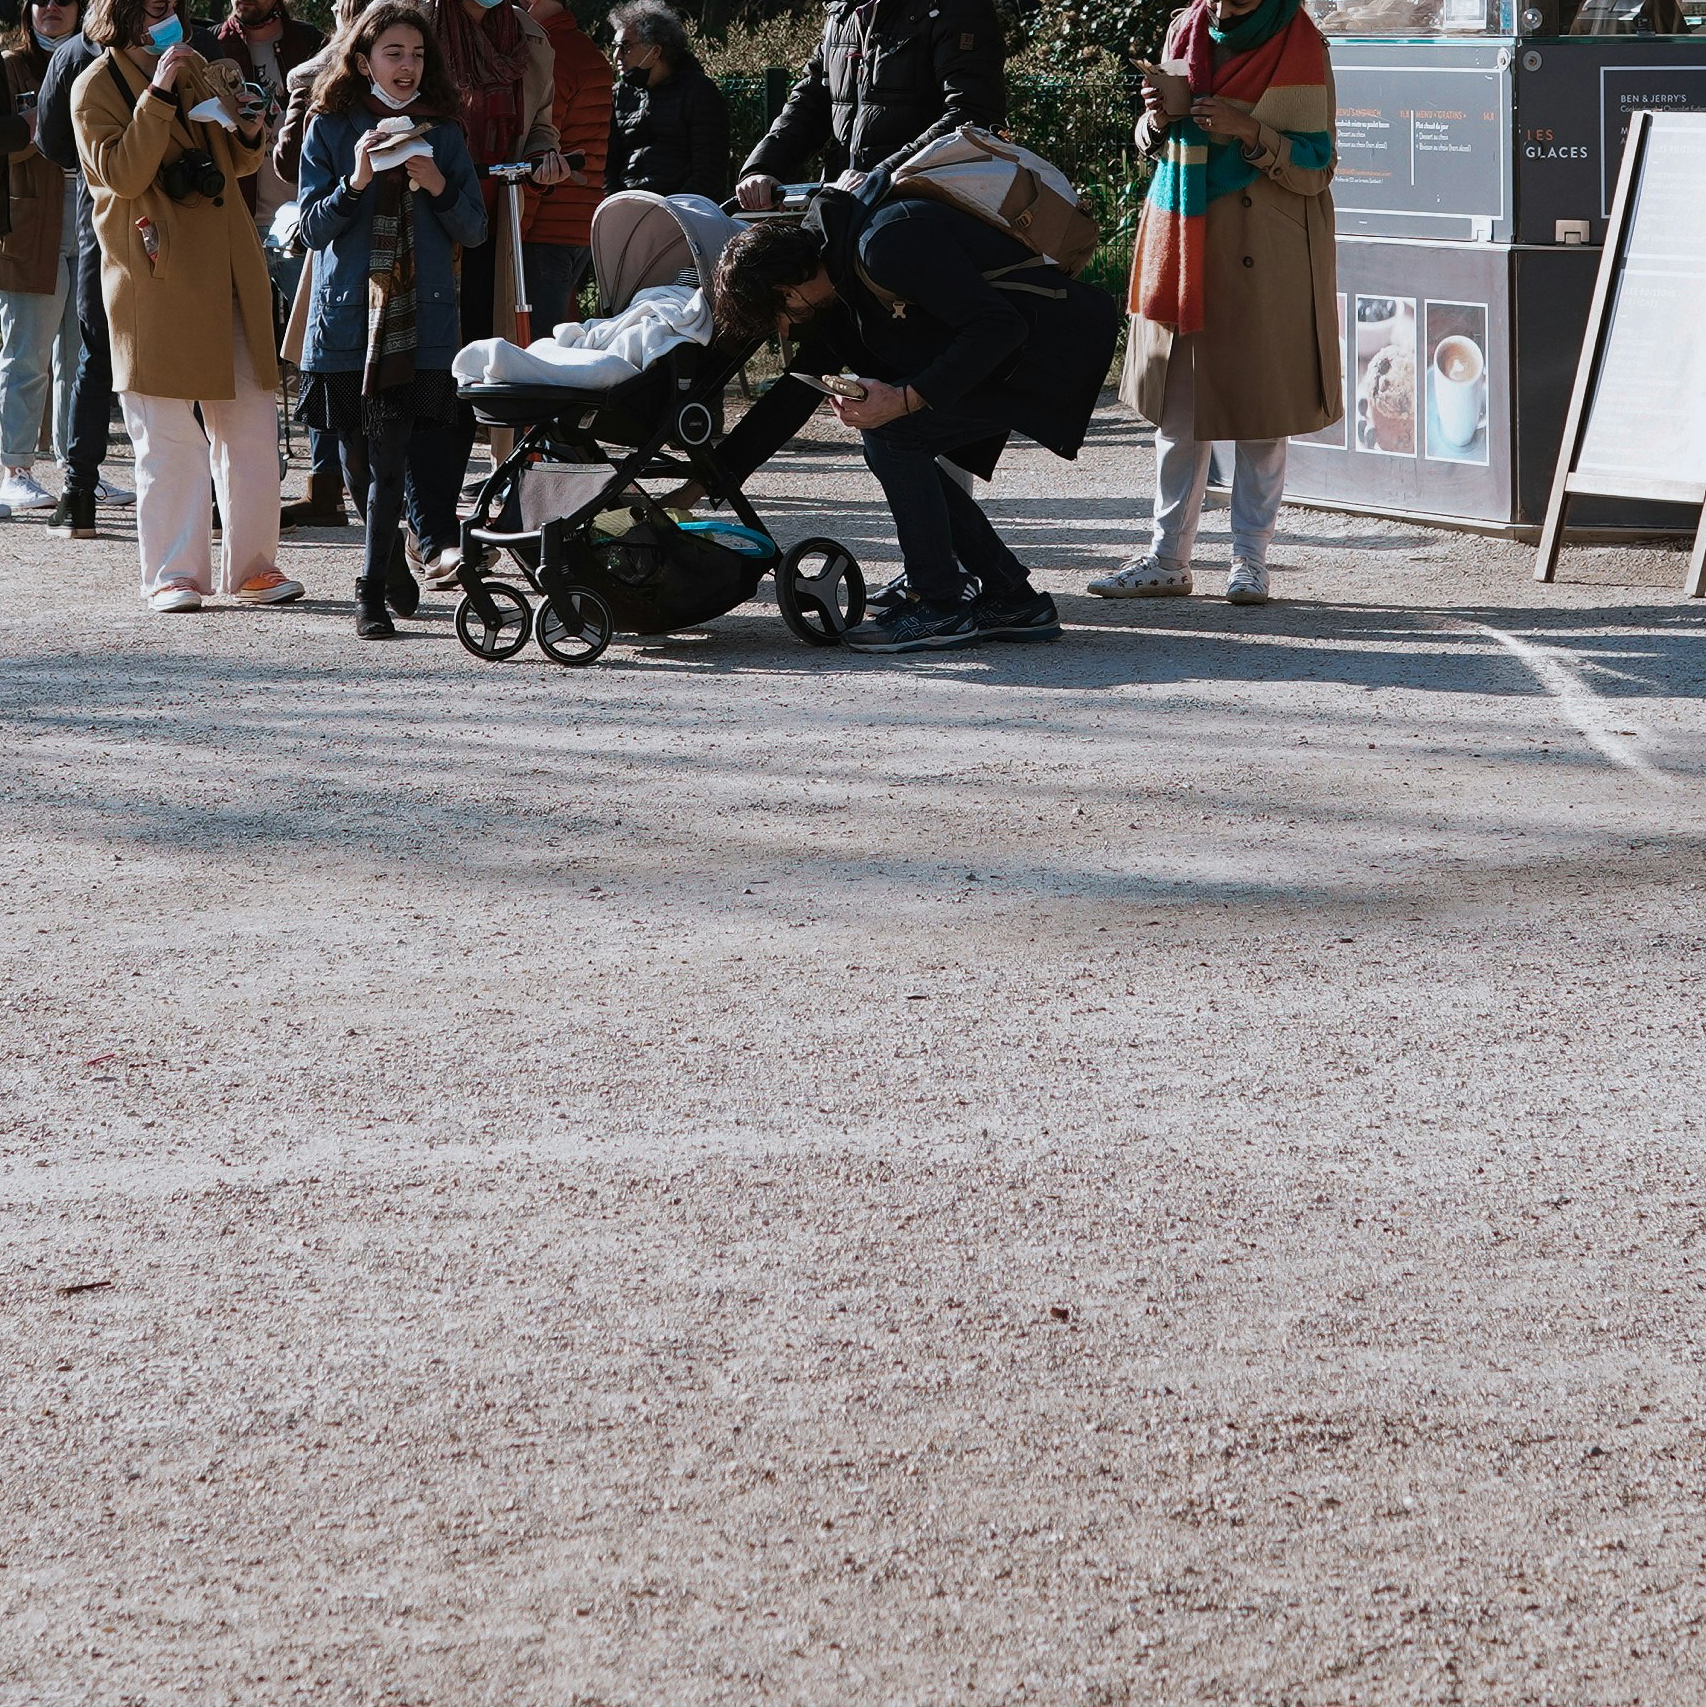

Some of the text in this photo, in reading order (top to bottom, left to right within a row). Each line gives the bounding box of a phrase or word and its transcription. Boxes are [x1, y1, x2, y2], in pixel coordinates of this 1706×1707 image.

[1620, 94, 1639, 103] BEN
[1642, 94, 1648, 103] &
[1650, 94, 1687, 103] JERRY'S
[1526, 129, 1554, 141] LES
[1525, 146, 1588, 158] GLACES
